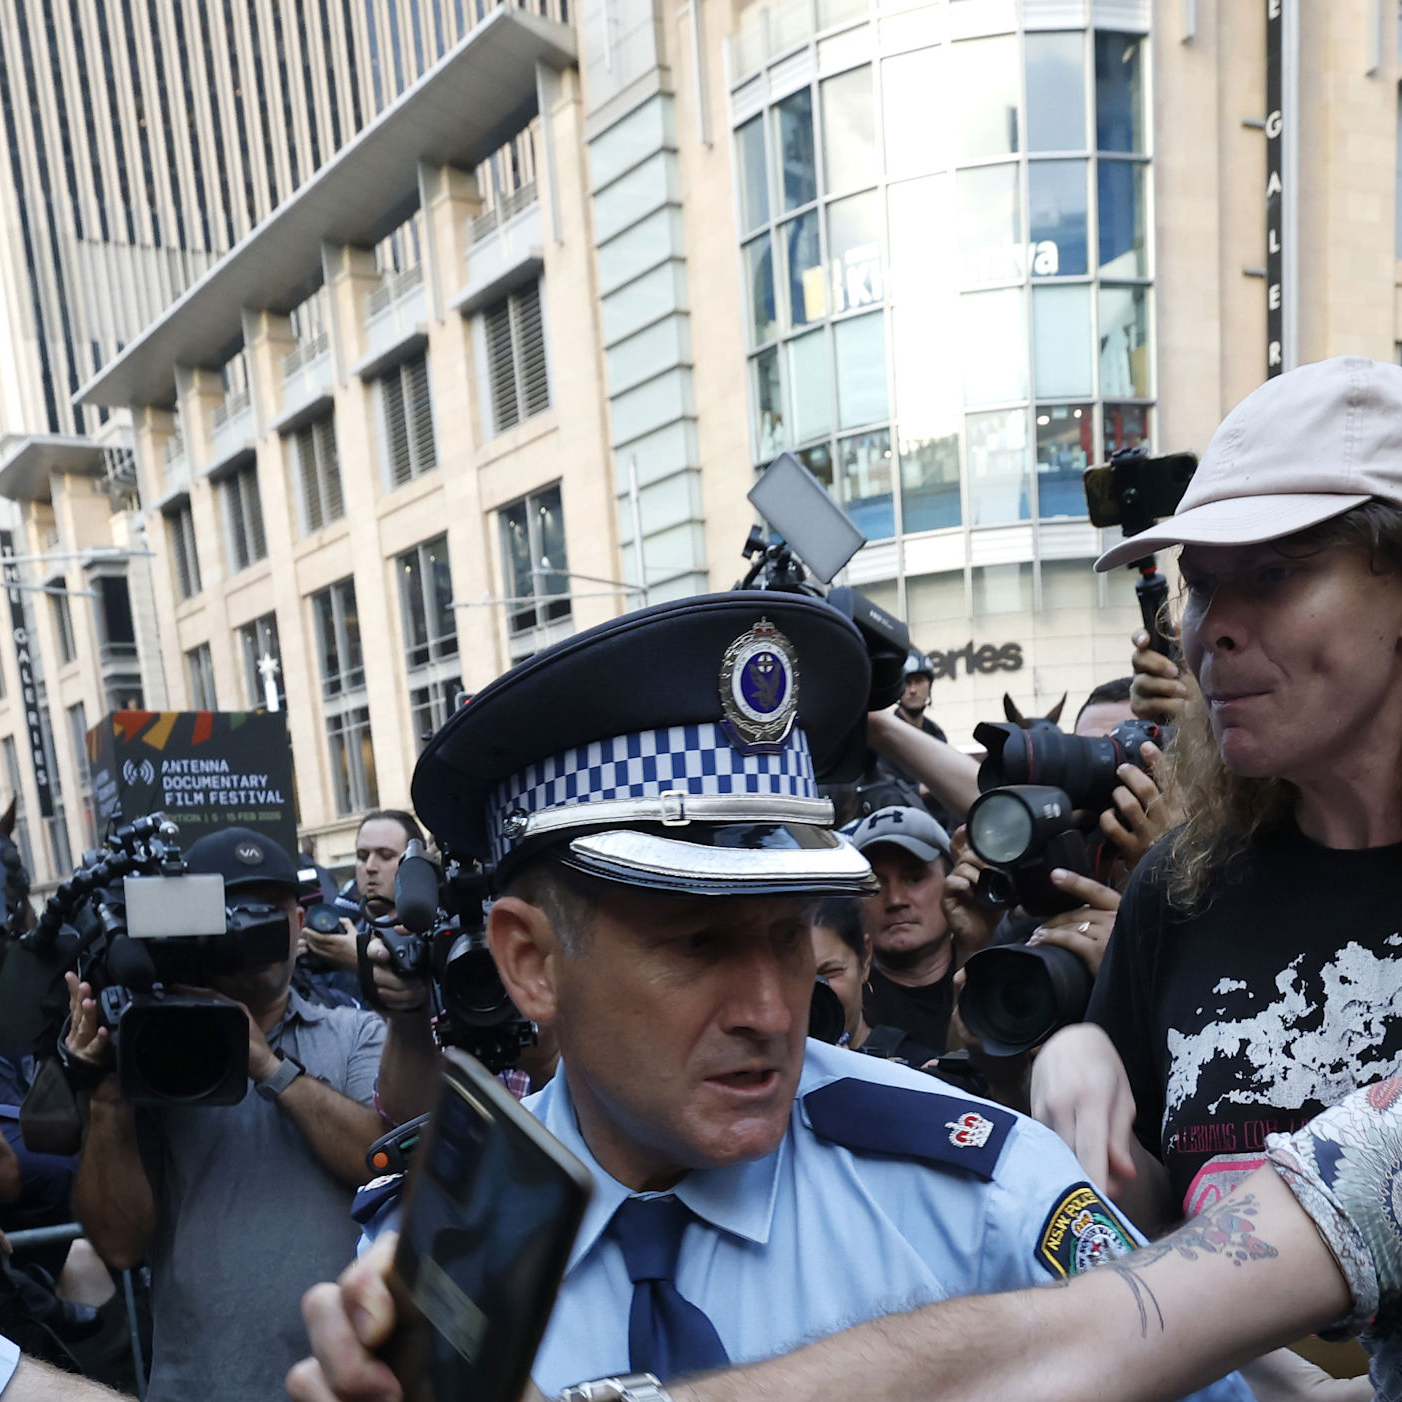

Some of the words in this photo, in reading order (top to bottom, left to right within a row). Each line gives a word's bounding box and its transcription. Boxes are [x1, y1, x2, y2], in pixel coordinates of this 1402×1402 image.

[13, 626, 49, 787] GALERIES
[161, 759, 230, 774] ANTENNA
[162, 774, 269, 791] DOCUMENTARY
[164, 790, 204, 806] FILM
[209, 788, 286, 805] FESTIVAL
